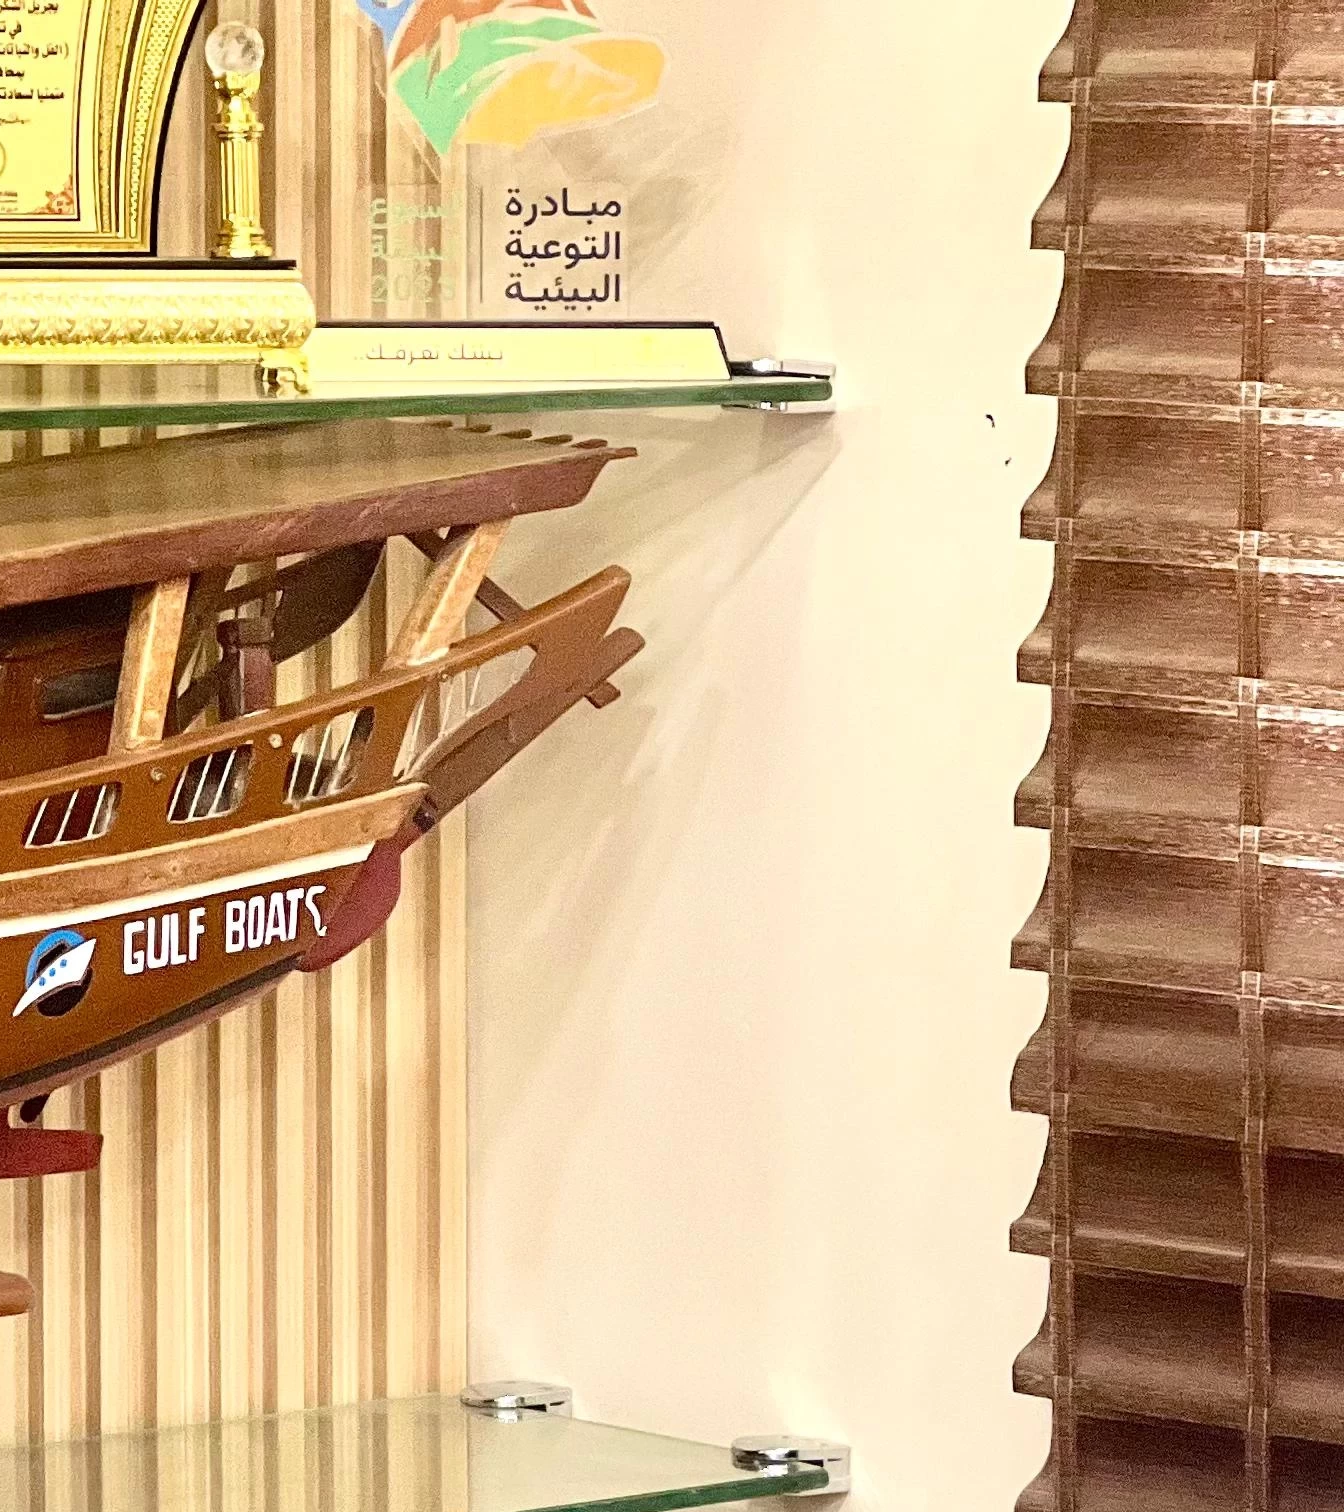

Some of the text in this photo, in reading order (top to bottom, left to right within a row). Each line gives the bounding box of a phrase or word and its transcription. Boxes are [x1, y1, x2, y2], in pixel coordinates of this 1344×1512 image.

[8, 20, 23, 40] في
[505, 187, 622, 227] مبادرة
[505, 230, 621, 269] التوعية
[504, 273, 621, 311] البيئية
[122, 884, 327, 976] GULF BOATS
